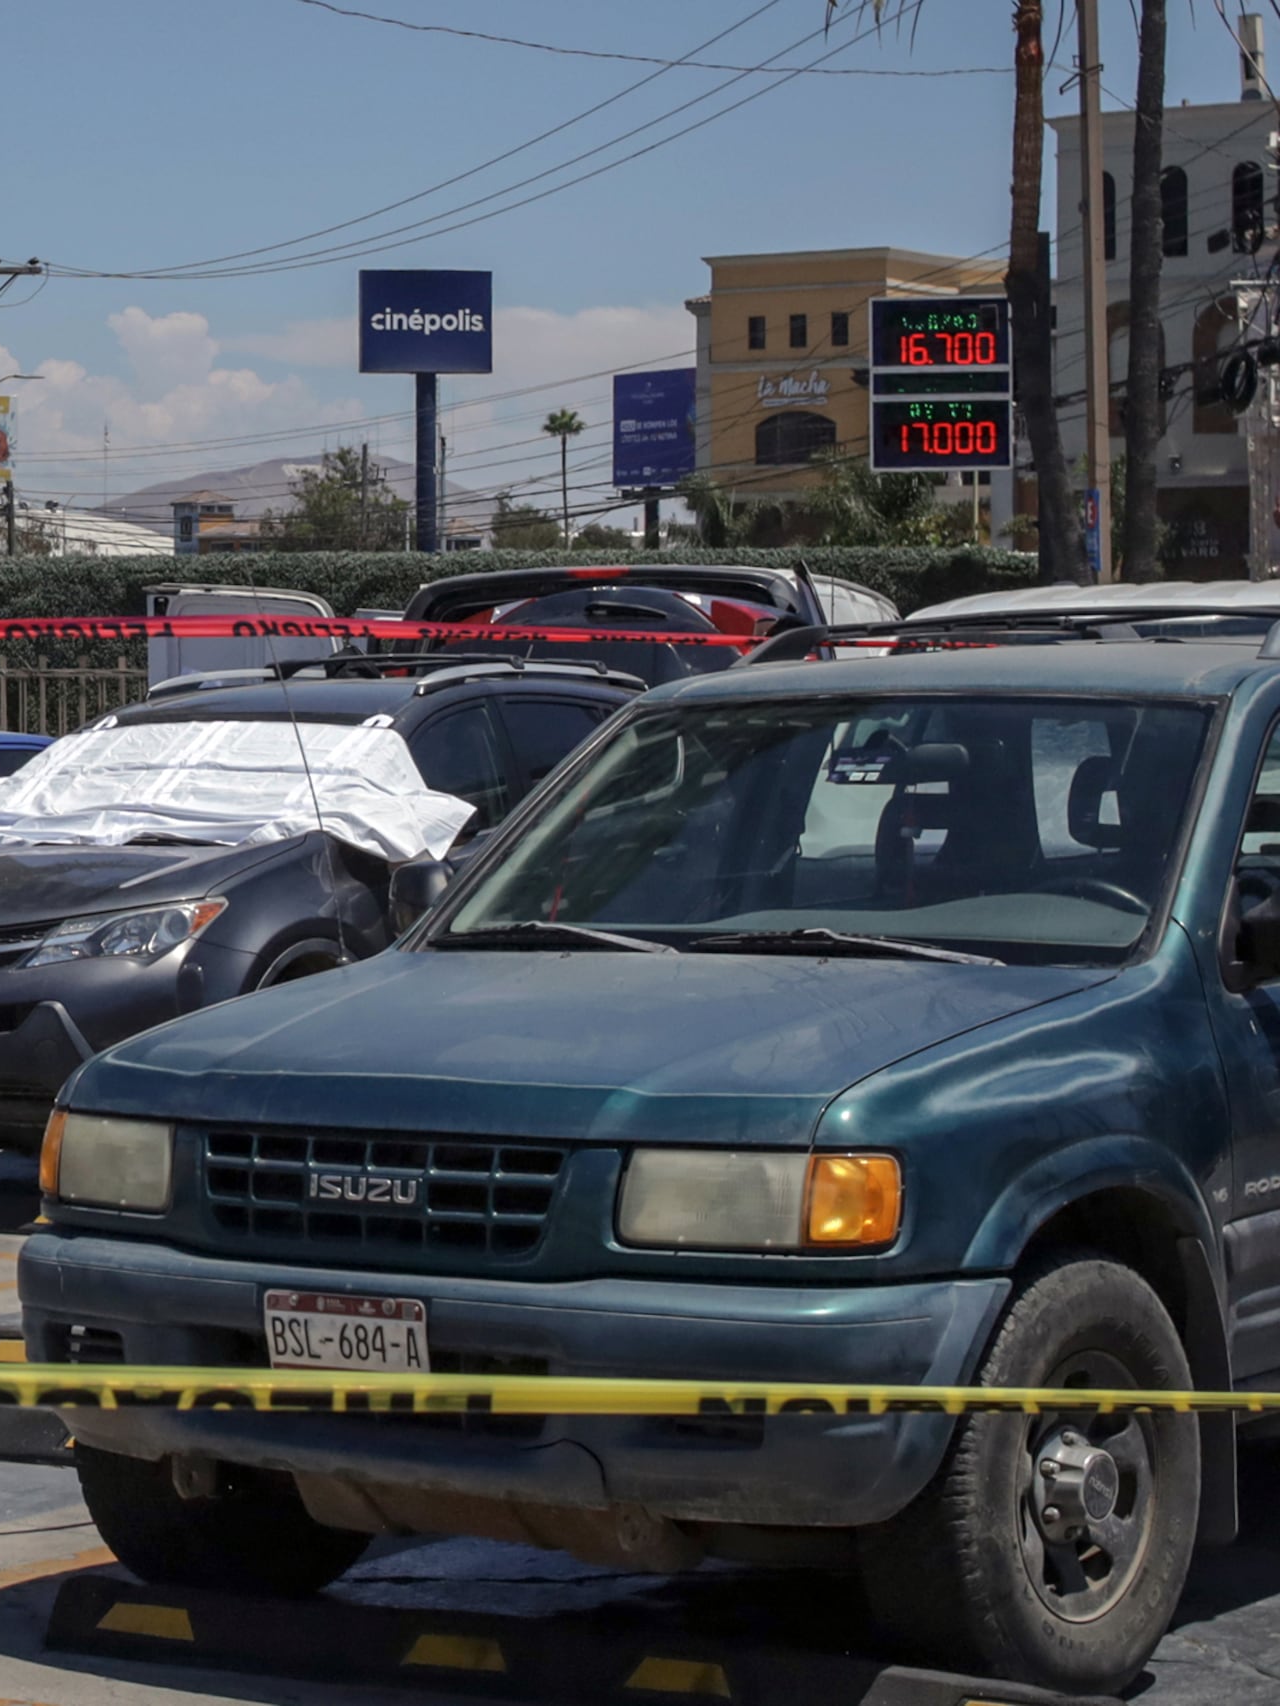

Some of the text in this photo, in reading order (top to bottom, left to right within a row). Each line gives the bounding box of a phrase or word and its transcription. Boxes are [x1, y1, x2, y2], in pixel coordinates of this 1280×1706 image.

[370, 307, 484, 335] cinépolis
[900, 331, 997, 366] 16.700
[901, 420, 998, 455] 17.000
[309, 1173, 417, 1204] ISUZU
[271, 1315, 421, 1369] BSL-684-A
